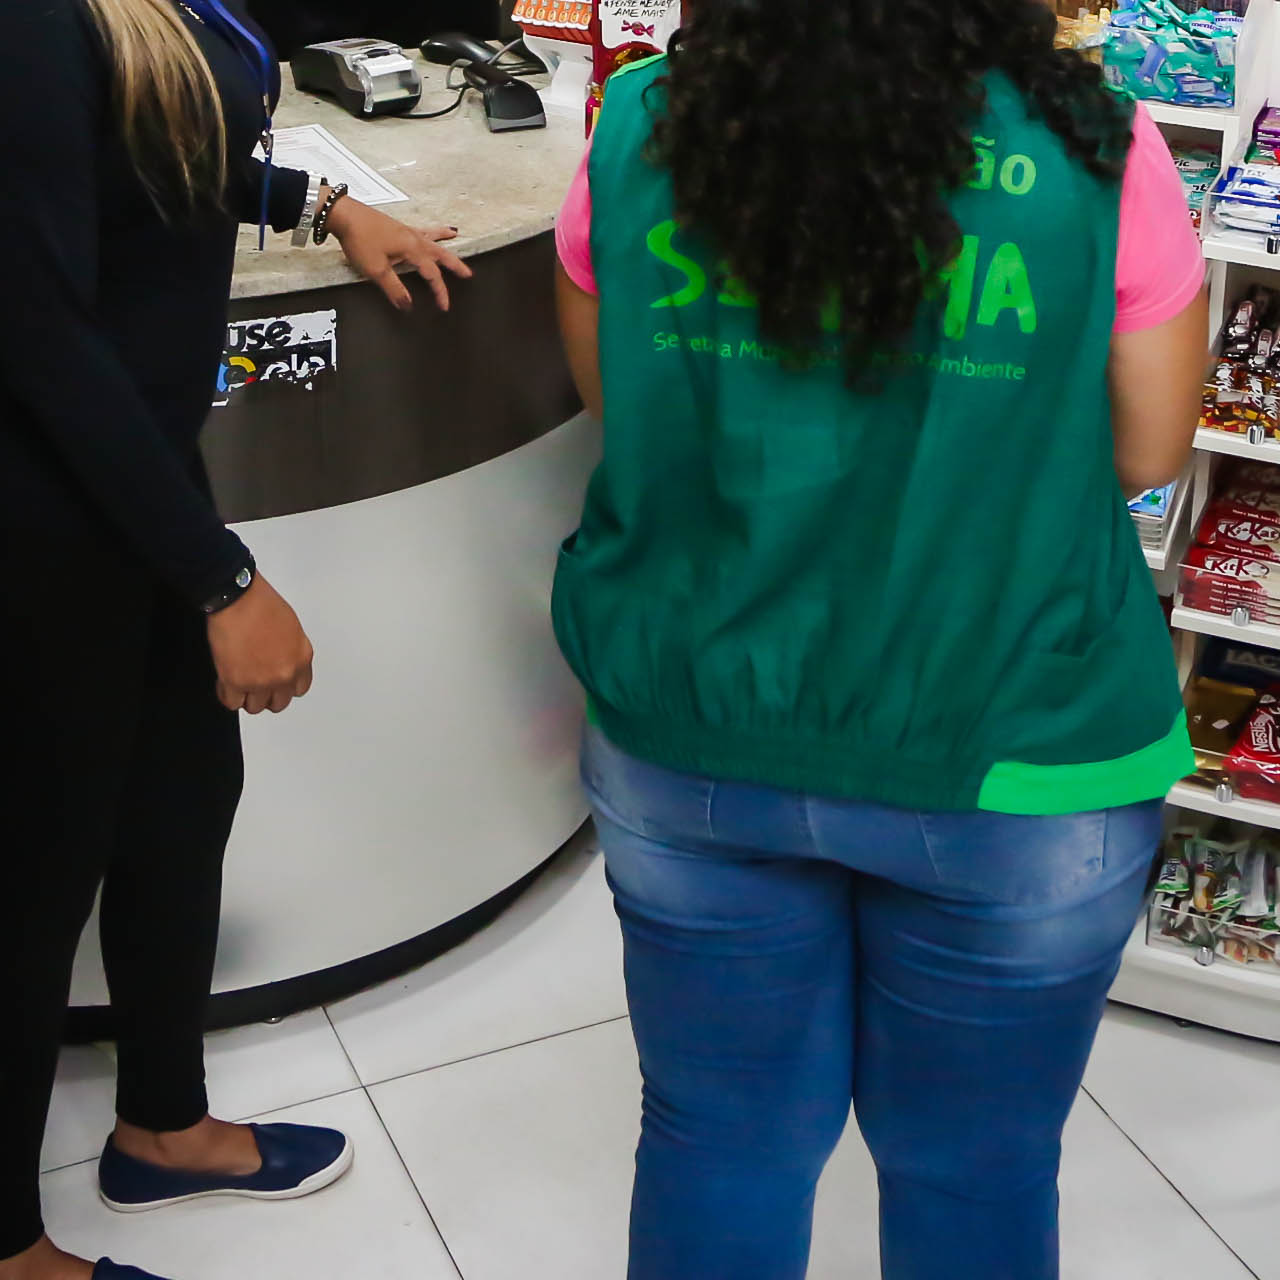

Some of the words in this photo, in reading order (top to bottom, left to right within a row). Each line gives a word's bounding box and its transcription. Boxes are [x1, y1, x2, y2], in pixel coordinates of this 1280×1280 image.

[612, 8, 638, 19] AME
[640, 9, 667, 19] MAIS
[1204, 555, 1270, 577] KitK
